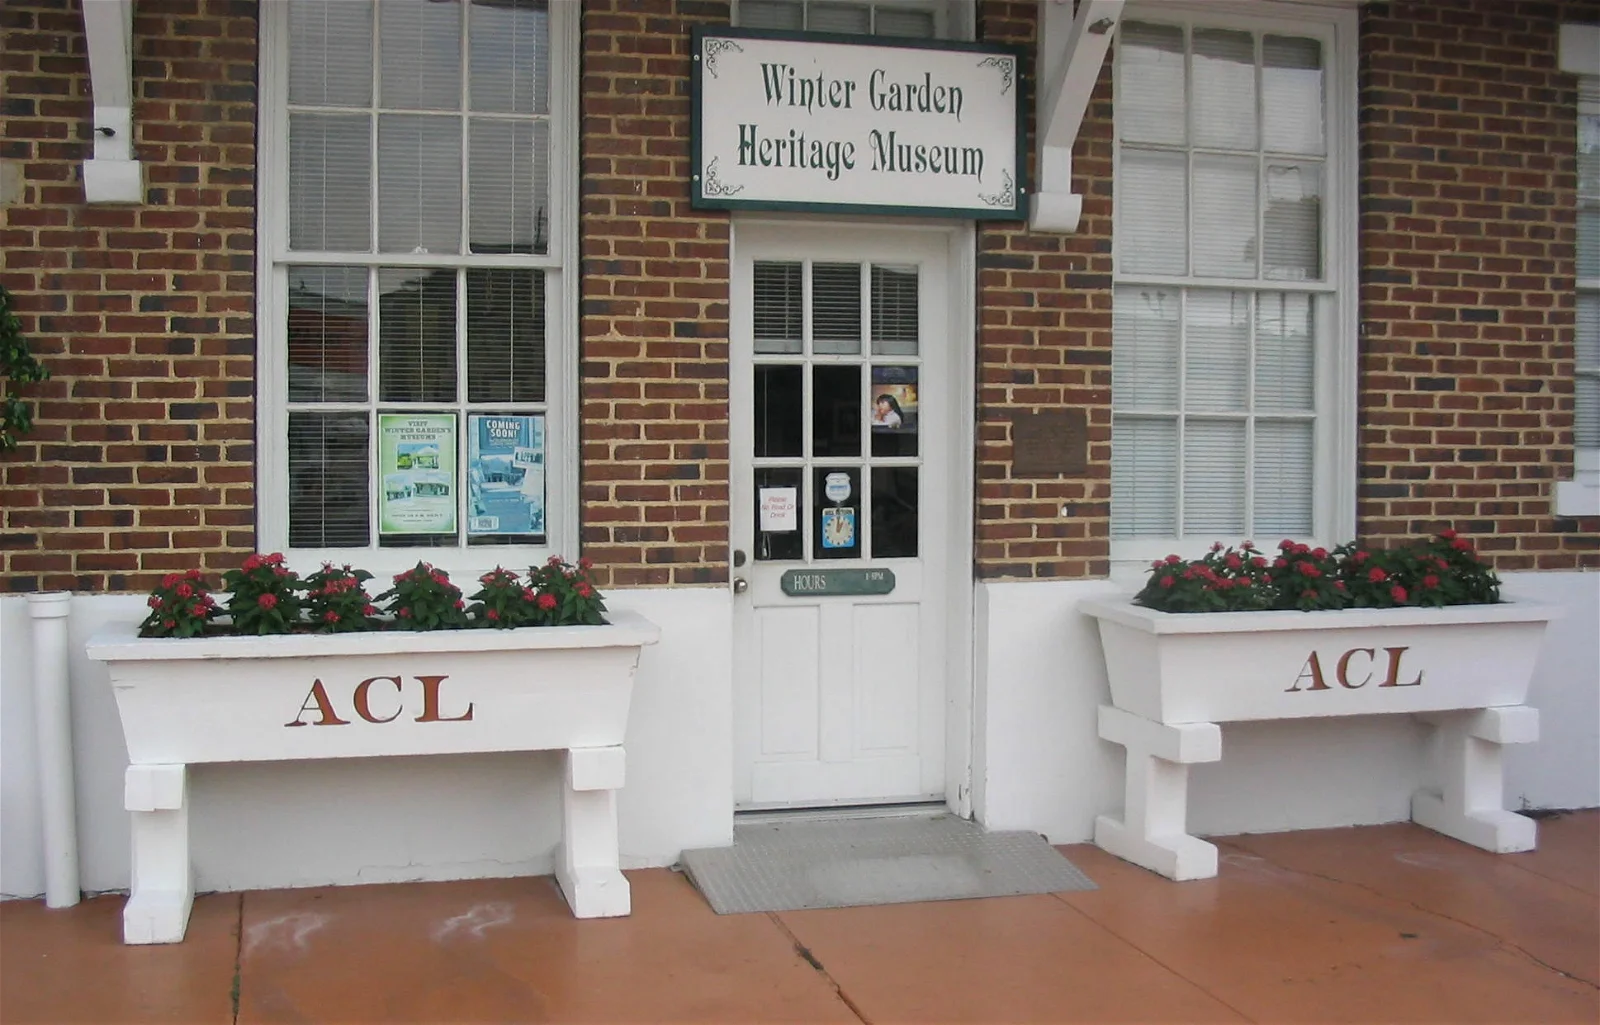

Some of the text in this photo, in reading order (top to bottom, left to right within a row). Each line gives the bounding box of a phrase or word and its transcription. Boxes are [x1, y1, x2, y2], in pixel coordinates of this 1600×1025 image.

[760, 63, 963, 122] Winter Garden
[737, 124, 984, 183] Heritage Museum
[486, 419, 521, 430] COMING
[490, 429, 517, 438] SOON!
[794, 574, 827, 590] HOURS
[1284, 646, 1424, 693] ACL
[284, 675, 475, 727] ACL
